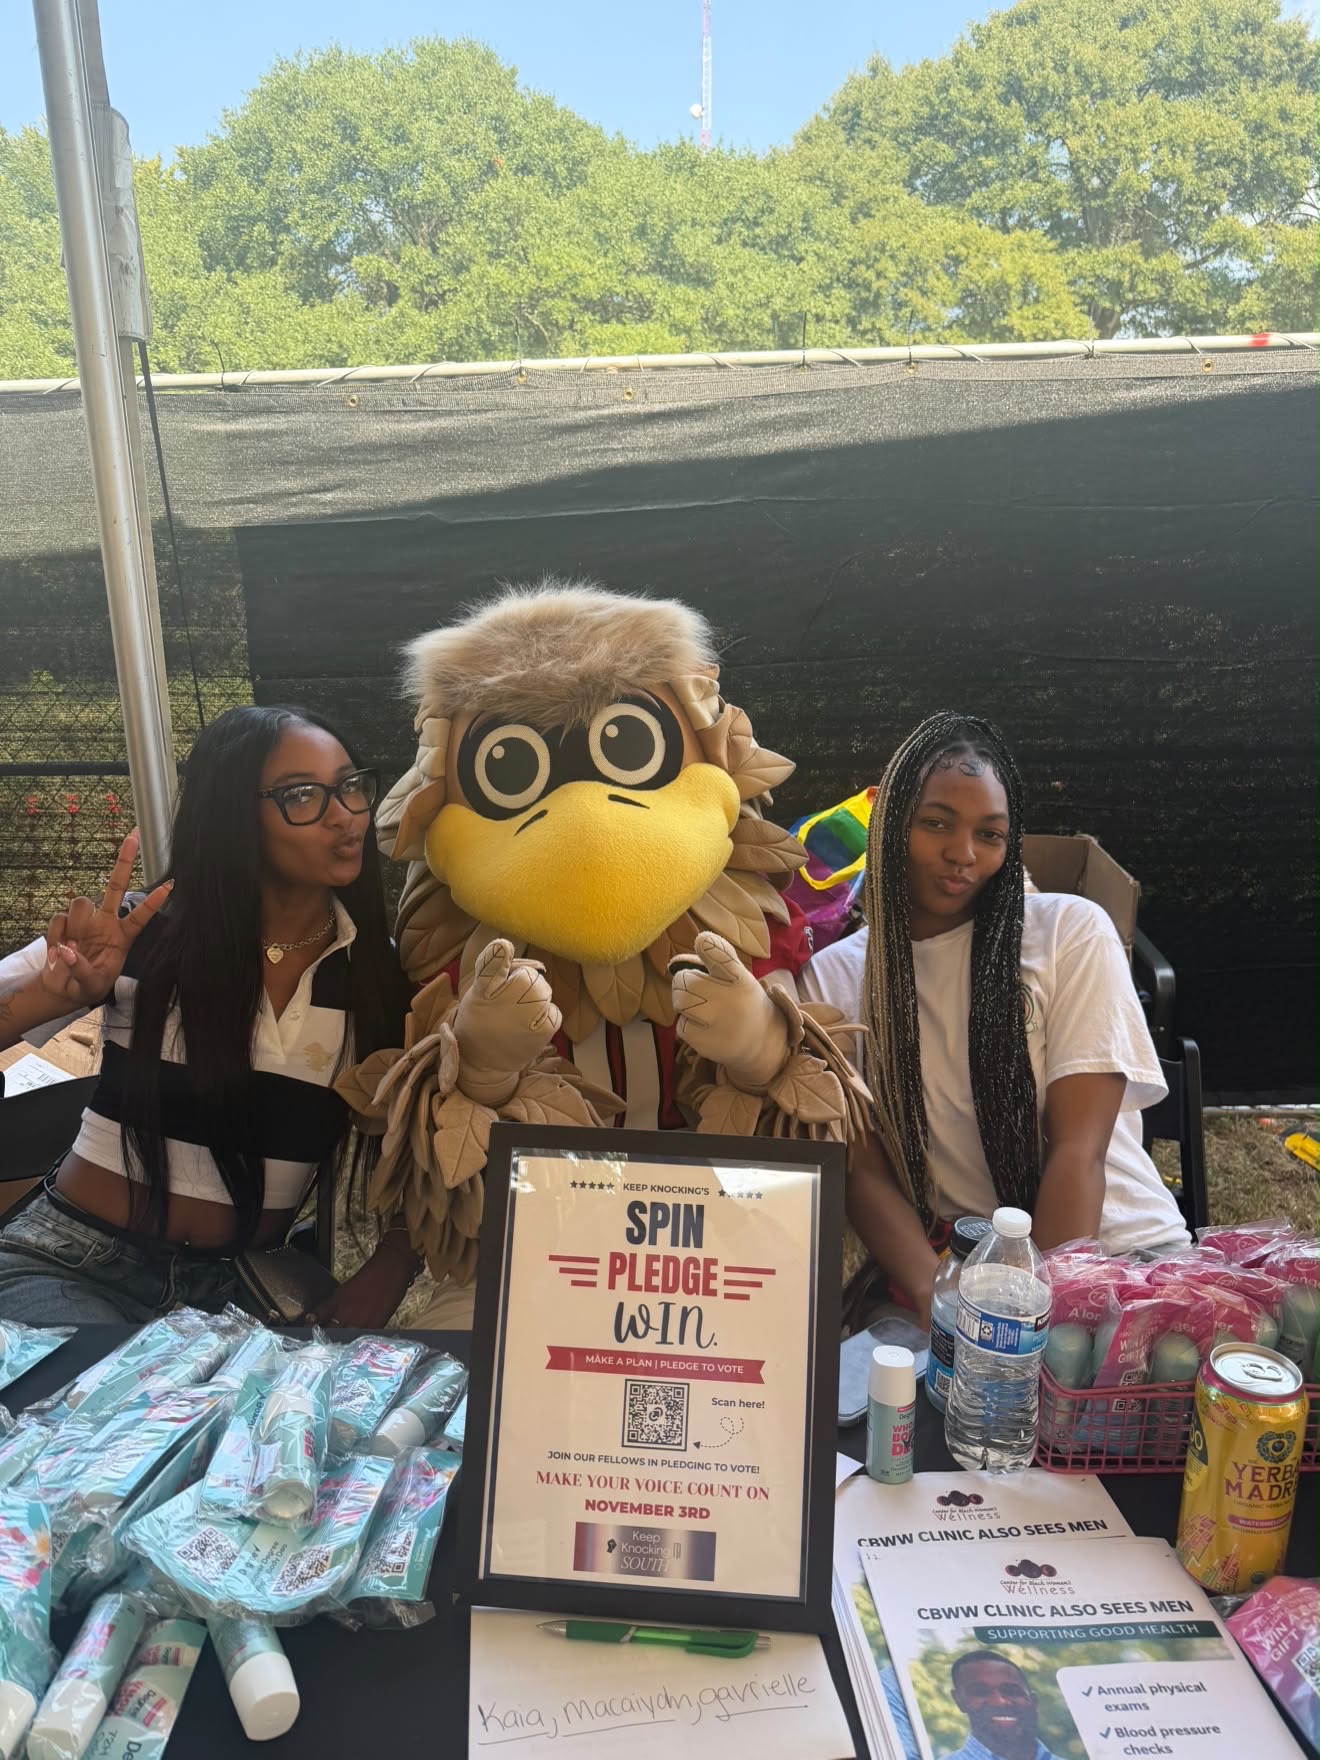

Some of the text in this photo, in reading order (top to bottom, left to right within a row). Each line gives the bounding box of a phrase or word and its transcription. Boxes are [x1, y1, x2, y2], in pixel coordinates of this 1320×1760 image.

[623, 1183, 710, 1196] KEEP KNOCKING'S
[625, 1200, 705, 1249] SPIN
[607, 1252, 719, 1297] PLEDGE
[585, 1354, 614, 1365] MAKE
[616, 1357, 624, 1366] A
[626, 1358, 653, 1368] PLAN
[660, 1361, 699, 1371] PLEDGE
[701, 1363, 715, 1372] TO
[717, 1365, 744, 1374] VOTE
[711, 1397, 765, 1409] Scan here!
[548, 1451, 760, 1474] JOIN OUR FELLOWS IN PLEDGING TO VOTE!
[536, 1470, 769, 1500] MAKE YOUR VOICE COUNT ON
[585, 1499, 711, 1519] NOVEMBER 3RD
[935, 1511, 1001, 1522] Wellness
[632, 1530, 661, 1543] Keep
[857, 1519, 1109, 1547] CBWW CLINIC ALSO SEES MEN
[621, 1542, 672, 1558] Knocking
[621, 1556, 671, 1573] SOUTH
[1002, 1584, 1075, 1596] Wellness
[917, 1599, 1195, 1620] CBWW CLINIC ALSO SEES MEN
[987, 1623, 1200, 1641] SUPPORTING GOOD HEALTH
[1262, 1622, 1288, 1650] WIN
[1271, 1628, 1300, 1662] GIFT
[1097, 1681, 1208, 1696] Annual physical
[1104, 1702, 1150, 1712] exams
[1114, 1724, 1222, 1739] Blood pressure
[1123, 1743, 1173, 1756] checks
